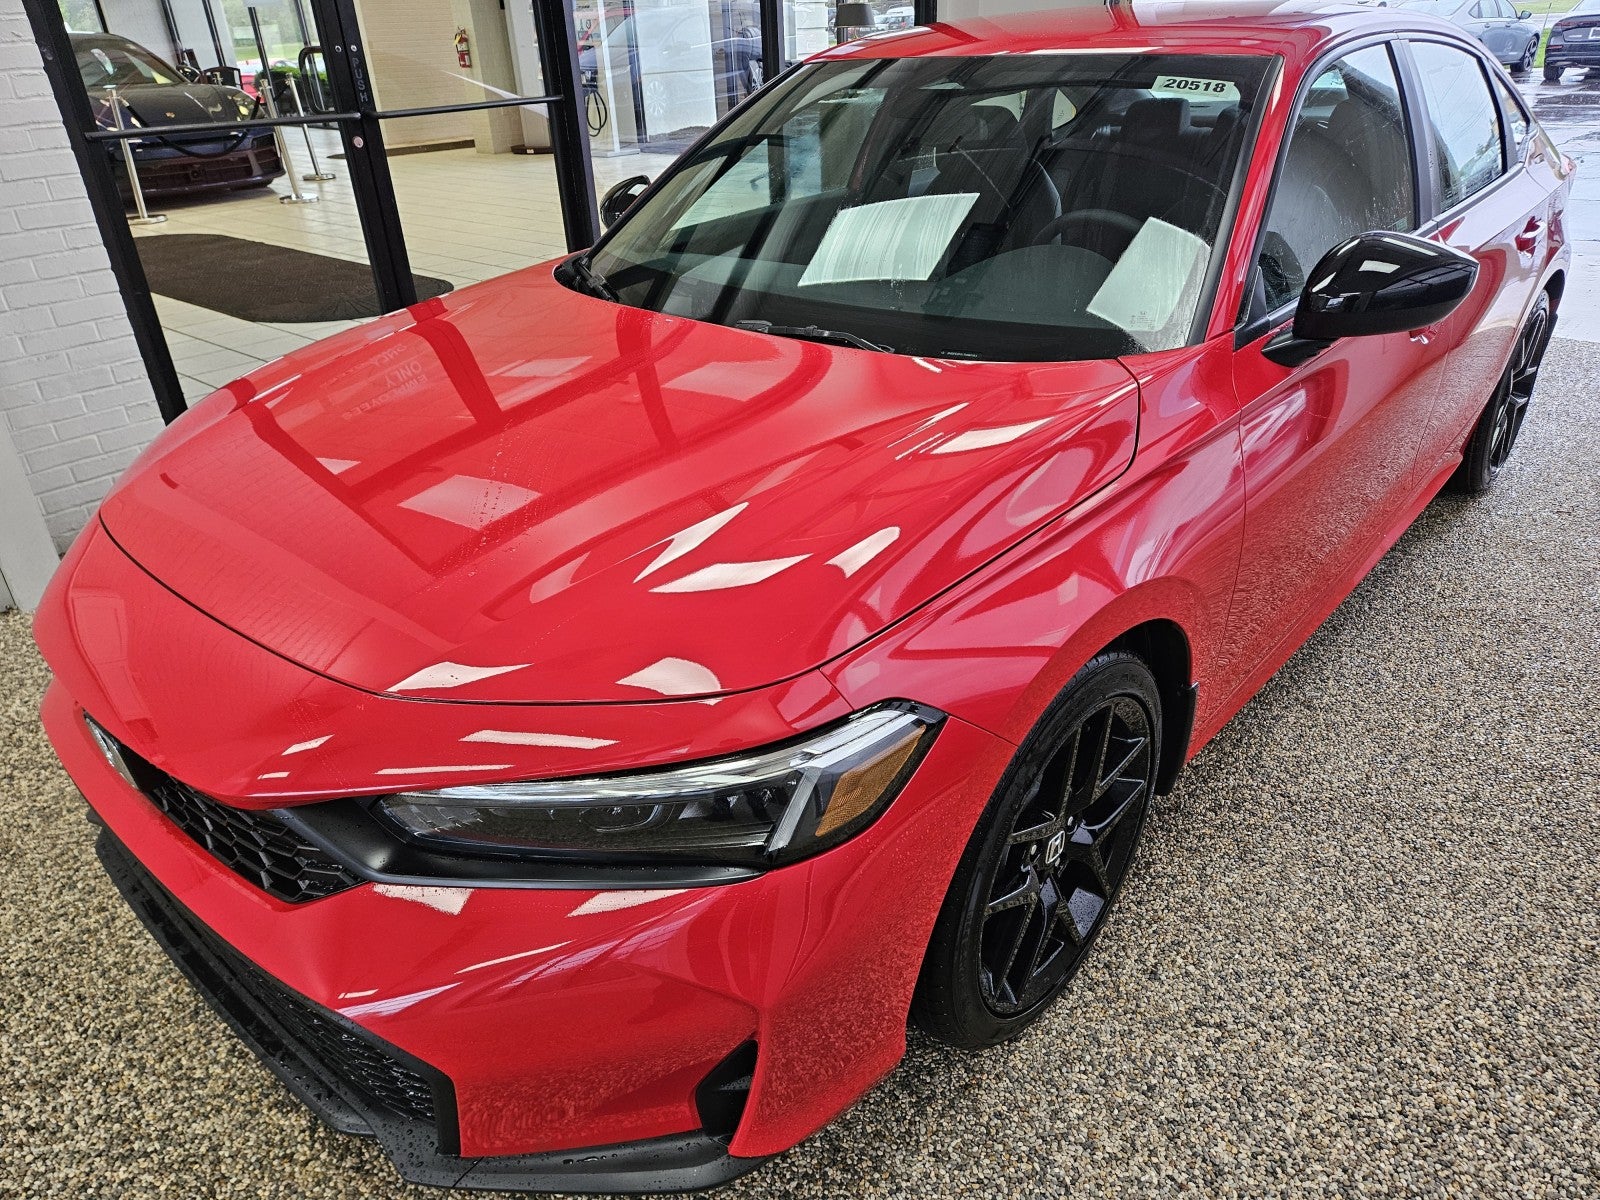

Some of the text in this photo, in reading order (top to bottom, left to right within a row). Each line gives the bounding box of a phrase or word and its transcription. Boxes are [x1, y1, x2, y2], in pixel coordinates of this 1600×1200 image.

[352, 57, 368, 103] PUSH
[1163, 78, 1227, 93] 20518
[384, 360, 422, 388] ONLY
